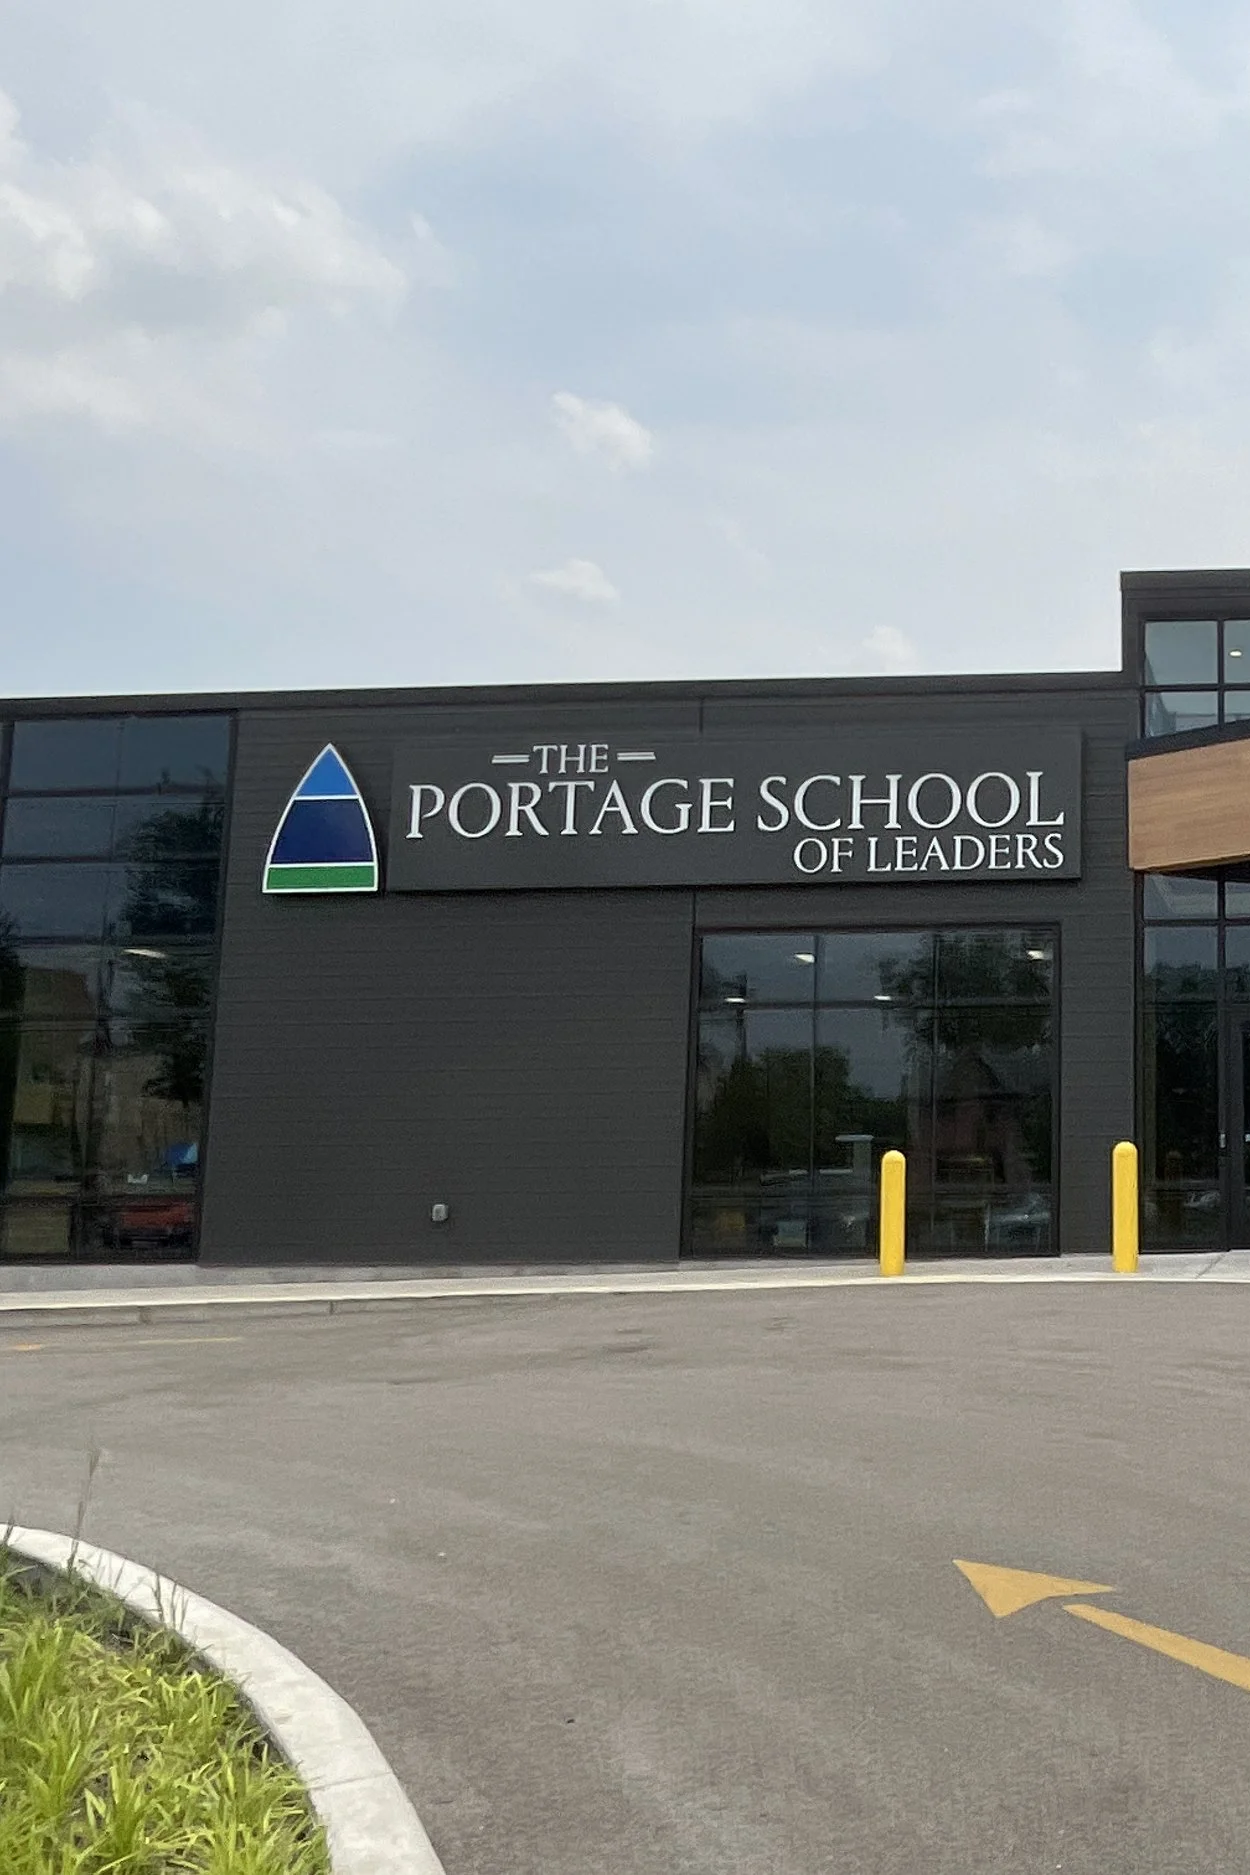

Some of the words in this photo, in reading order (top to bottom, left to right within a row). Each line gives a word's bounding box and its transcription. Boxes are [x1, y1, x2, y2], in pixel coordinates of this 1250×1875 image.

[532, 744, 609, 774] THE
[405, 778, 735, 839] PORTAGE
[757, 771, 1065, 832] SCHOOL
[793, 837, 854, 874] OF
[866, 832, 1064, 872] LEADERS
